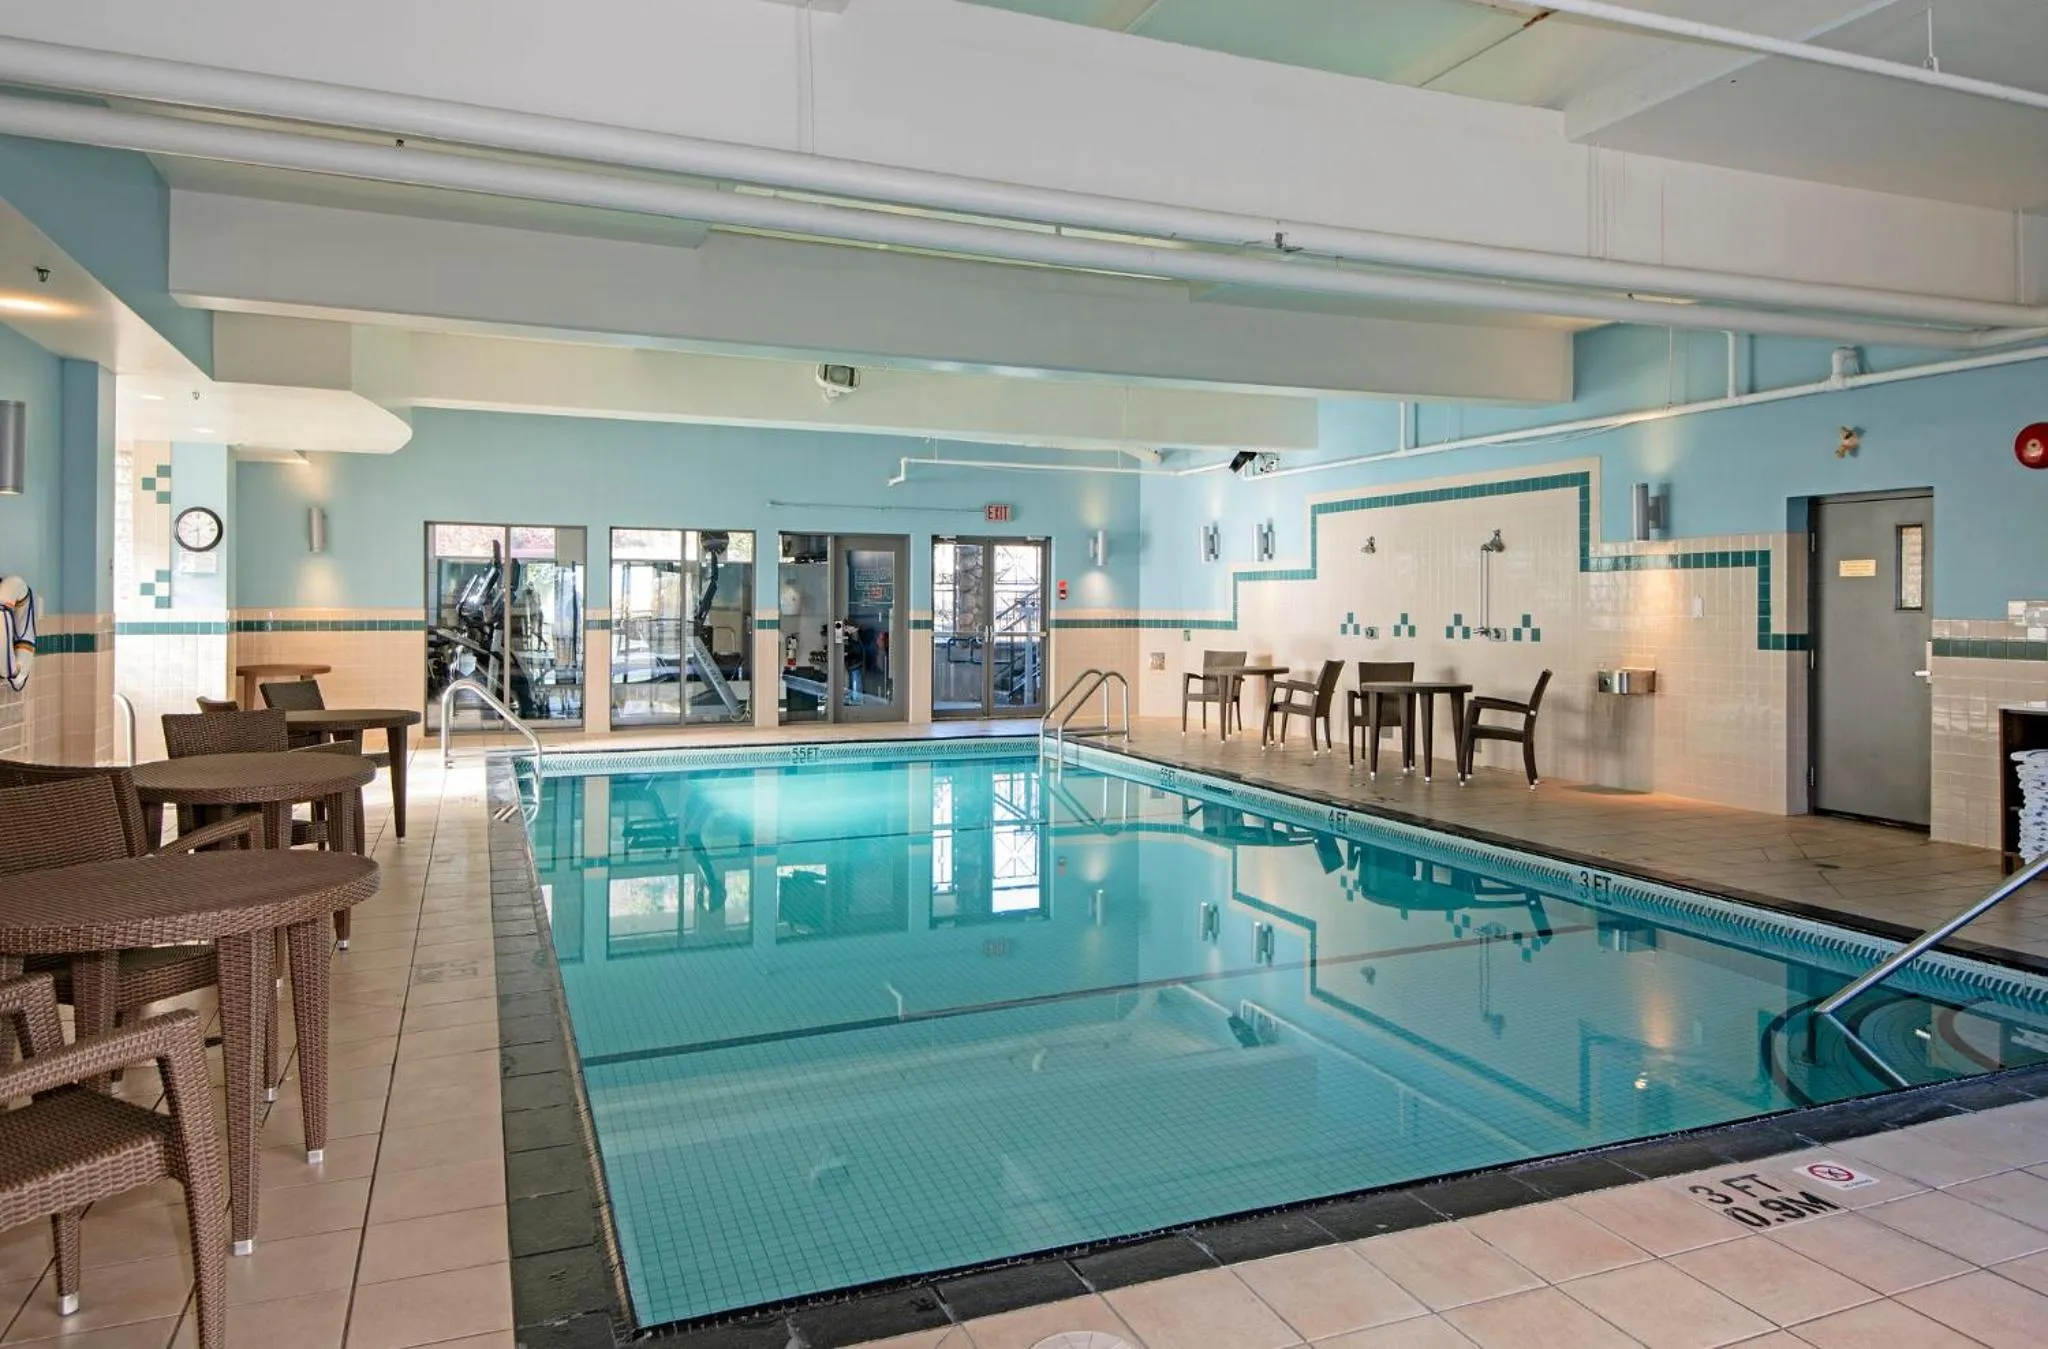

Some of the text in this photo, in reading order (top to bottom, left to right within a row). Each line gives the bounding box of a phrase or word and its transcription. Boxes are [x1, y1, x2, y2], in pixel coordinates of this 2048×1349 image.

[988, 505, 1008, 521] EXIT
[1579, 870, 1612, 893] 3 FT
[1689, 1173, 1782, 1205] 3 FT
[1723, 1191, 1840, 1227] 0.9M
